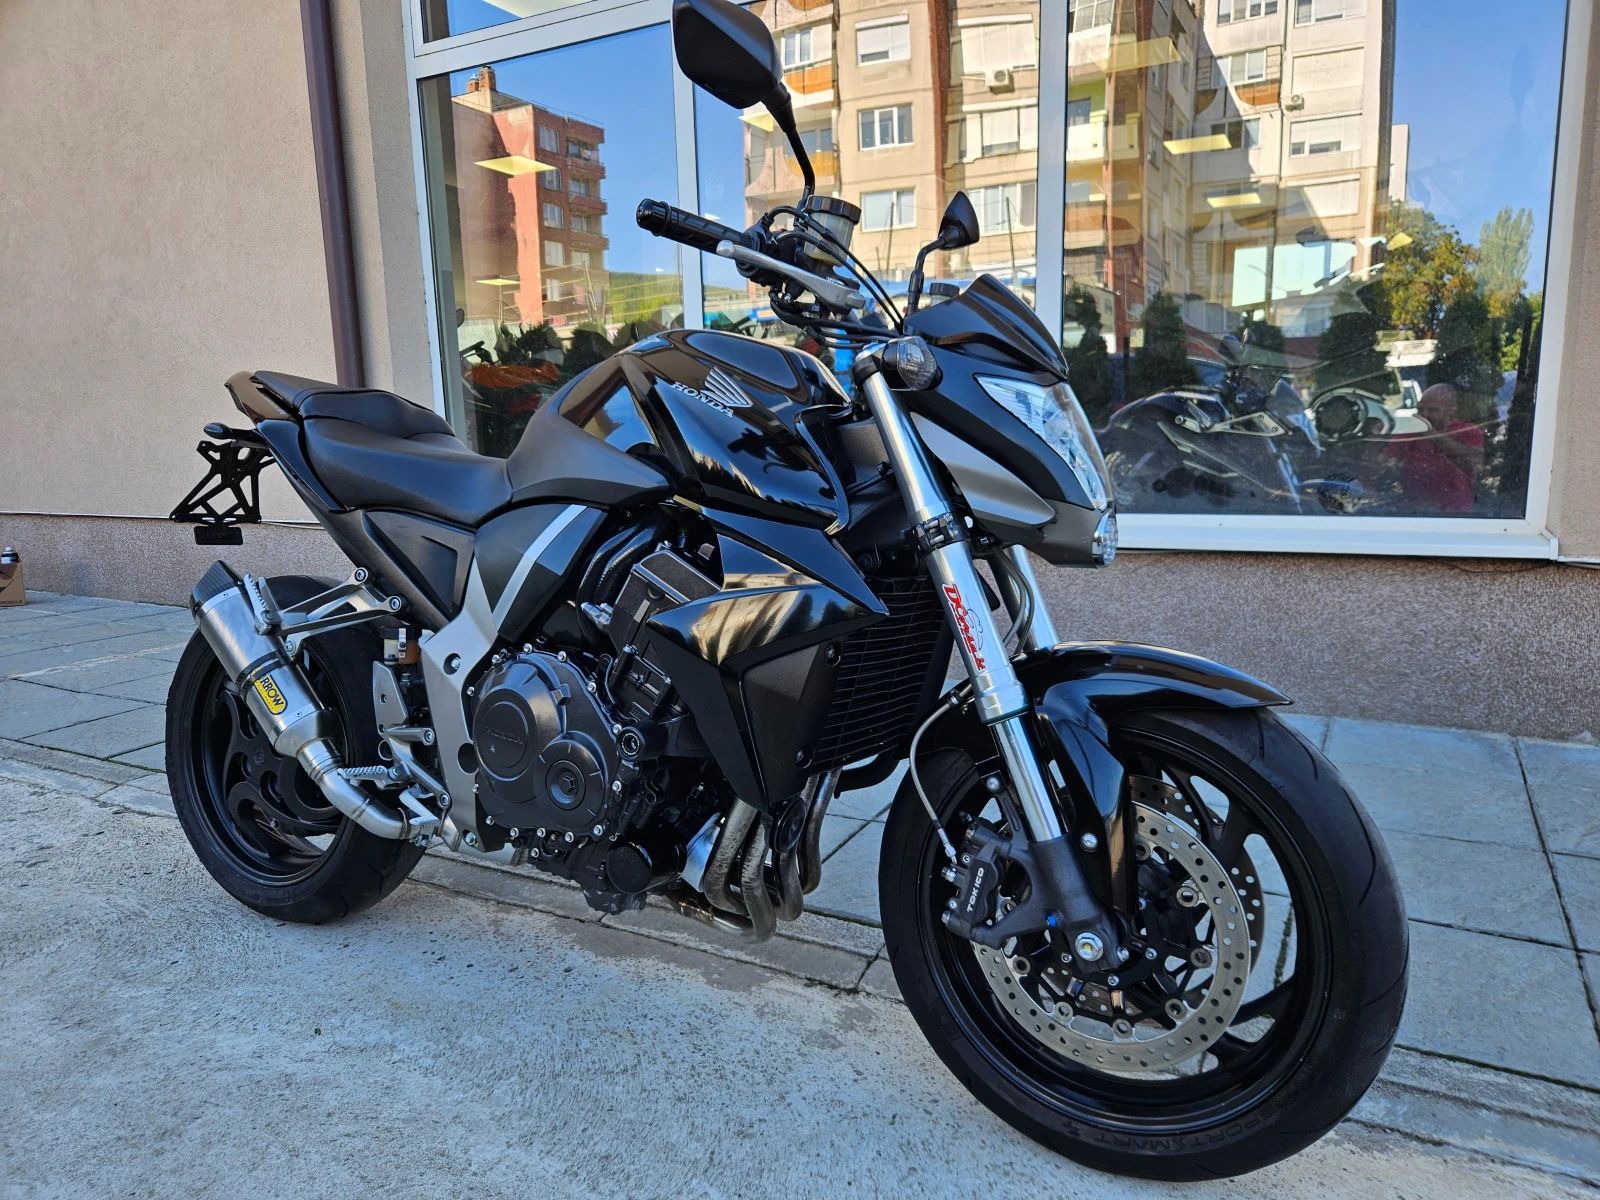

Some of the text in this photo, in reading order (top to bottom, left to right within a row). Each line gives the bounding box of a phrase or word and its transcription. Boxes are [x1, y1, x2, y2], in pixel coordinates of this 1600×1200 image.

[670, 381, 734, 418] HONDA
[485, 726, 524, 745] HONDA
[966, 867, 985, 913] TOKICO
